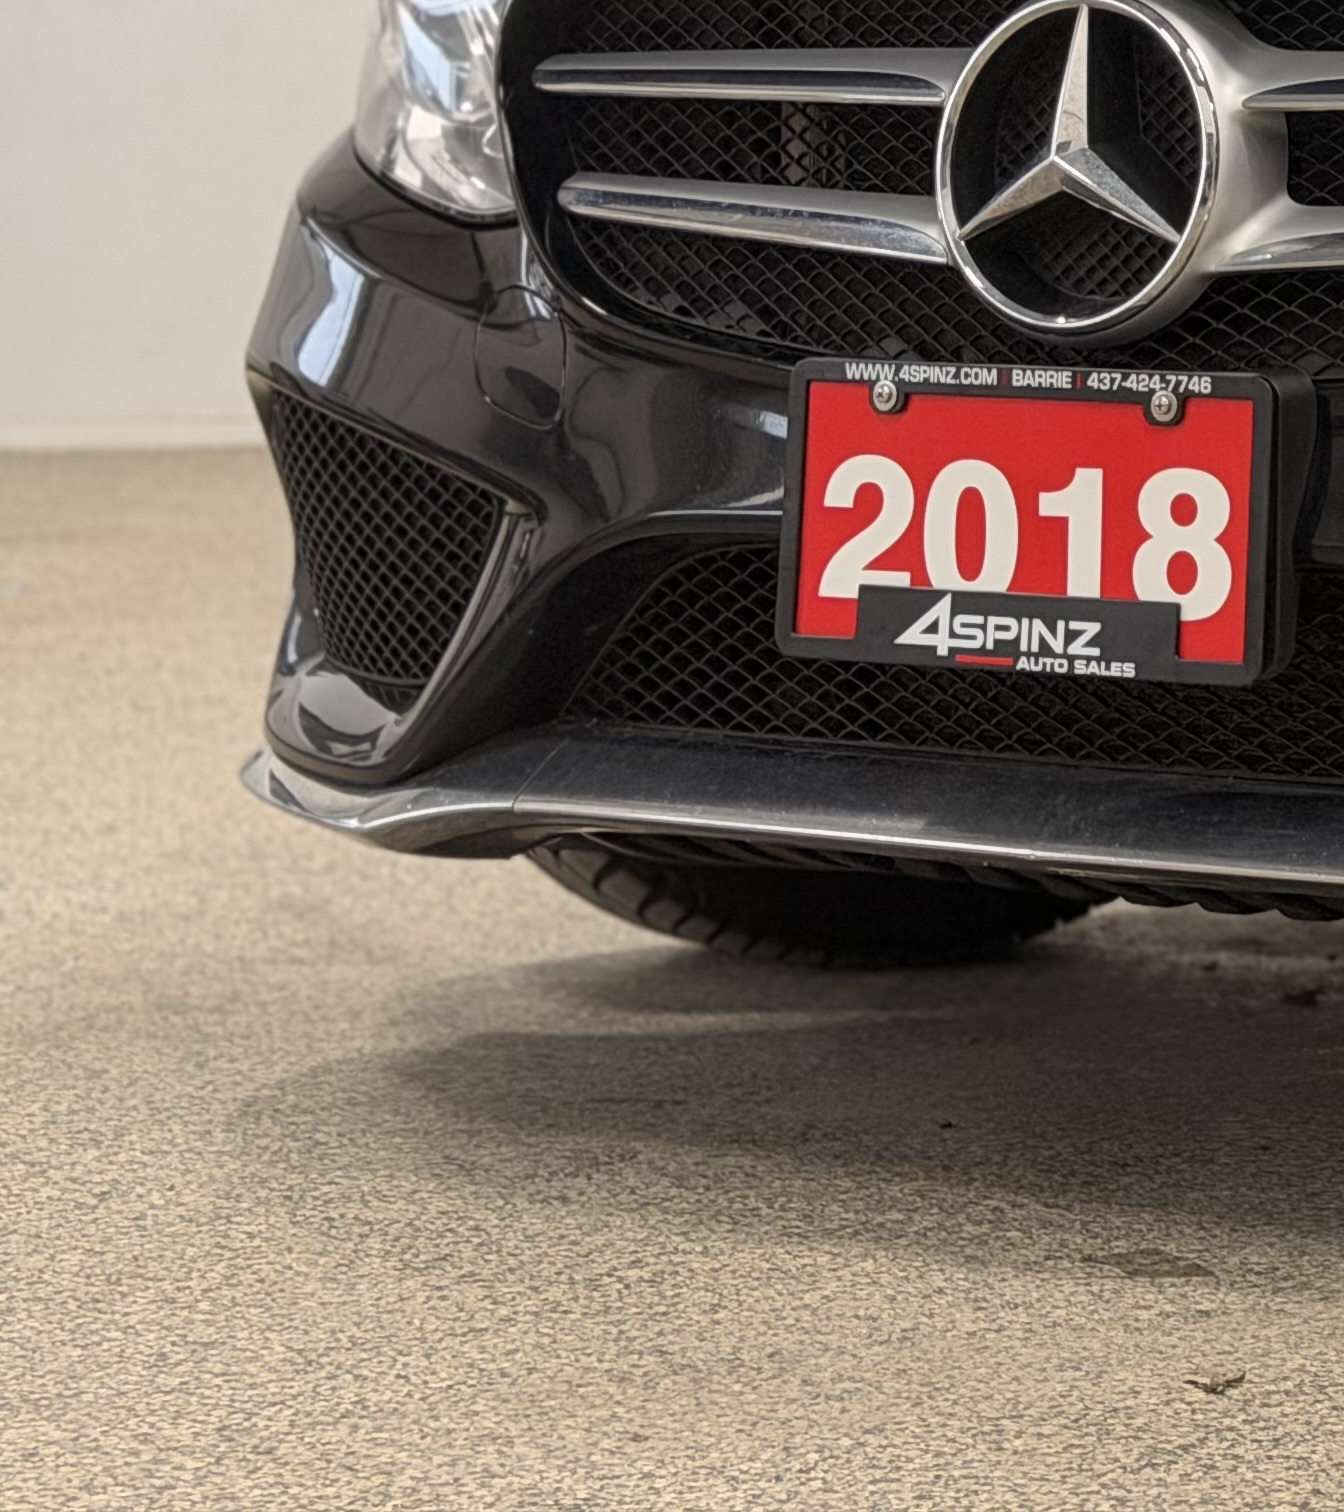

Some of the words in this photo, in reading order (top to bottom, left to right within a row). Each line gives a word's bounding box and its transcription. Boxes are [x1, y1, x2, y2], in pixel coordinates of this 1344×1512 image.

[845, 362, 998, 386] WWW.4SPINZ.COM
[1011, 369, 1073, 389] BARRIE
[1086, 372, 1213, 395] 437-424-7746
[817, 454, 1233, 622] 2018
[893, 592, 1102, 657] 4SPINZ
[1016, 655, 1068, 675] AUTO
[1073, 659, 1136, 679] SALES
